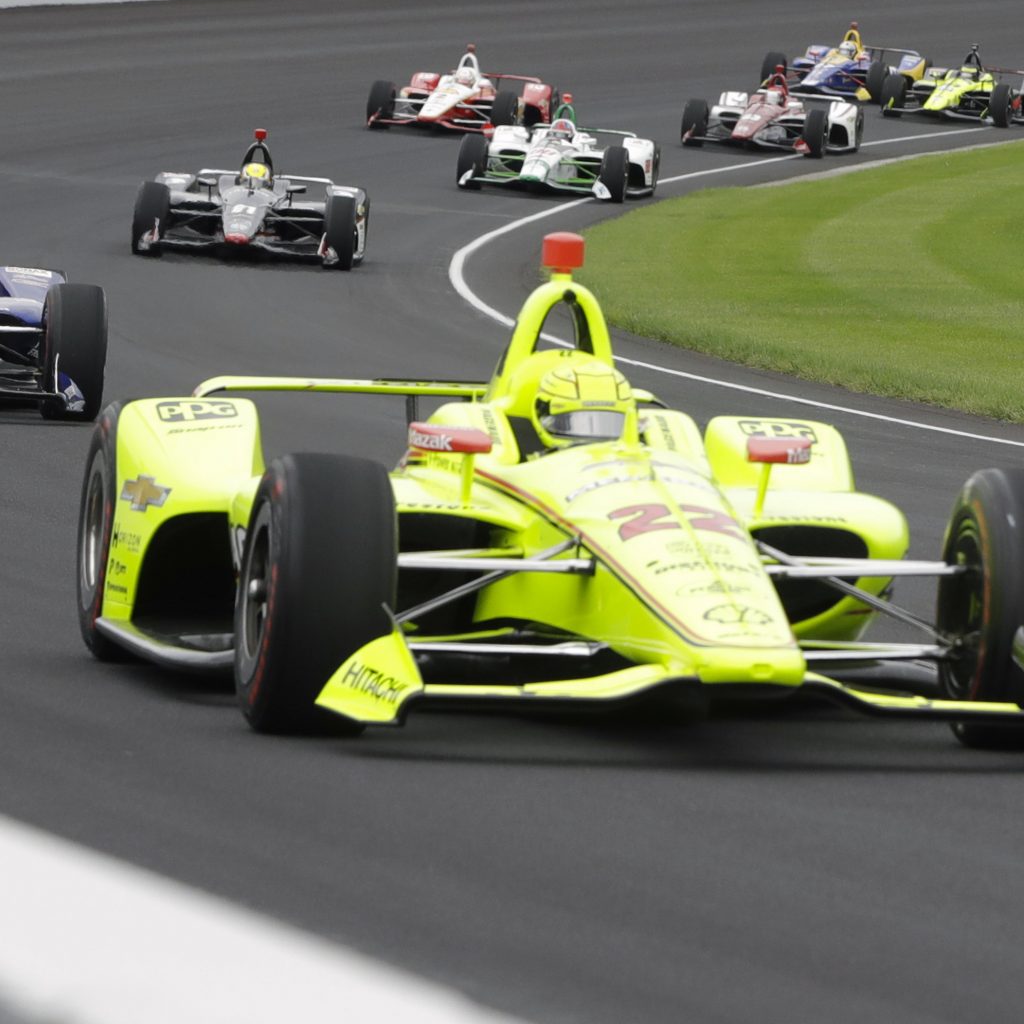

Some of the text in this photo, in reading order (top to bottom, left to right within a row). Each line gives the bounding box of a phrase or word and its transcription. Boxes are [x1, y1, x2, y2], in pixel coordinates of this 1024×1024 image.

[157, 400, 238, 422] PPG
[606, 503, 748, 542] 22
[341, 661, 408, 704] HITACHI
